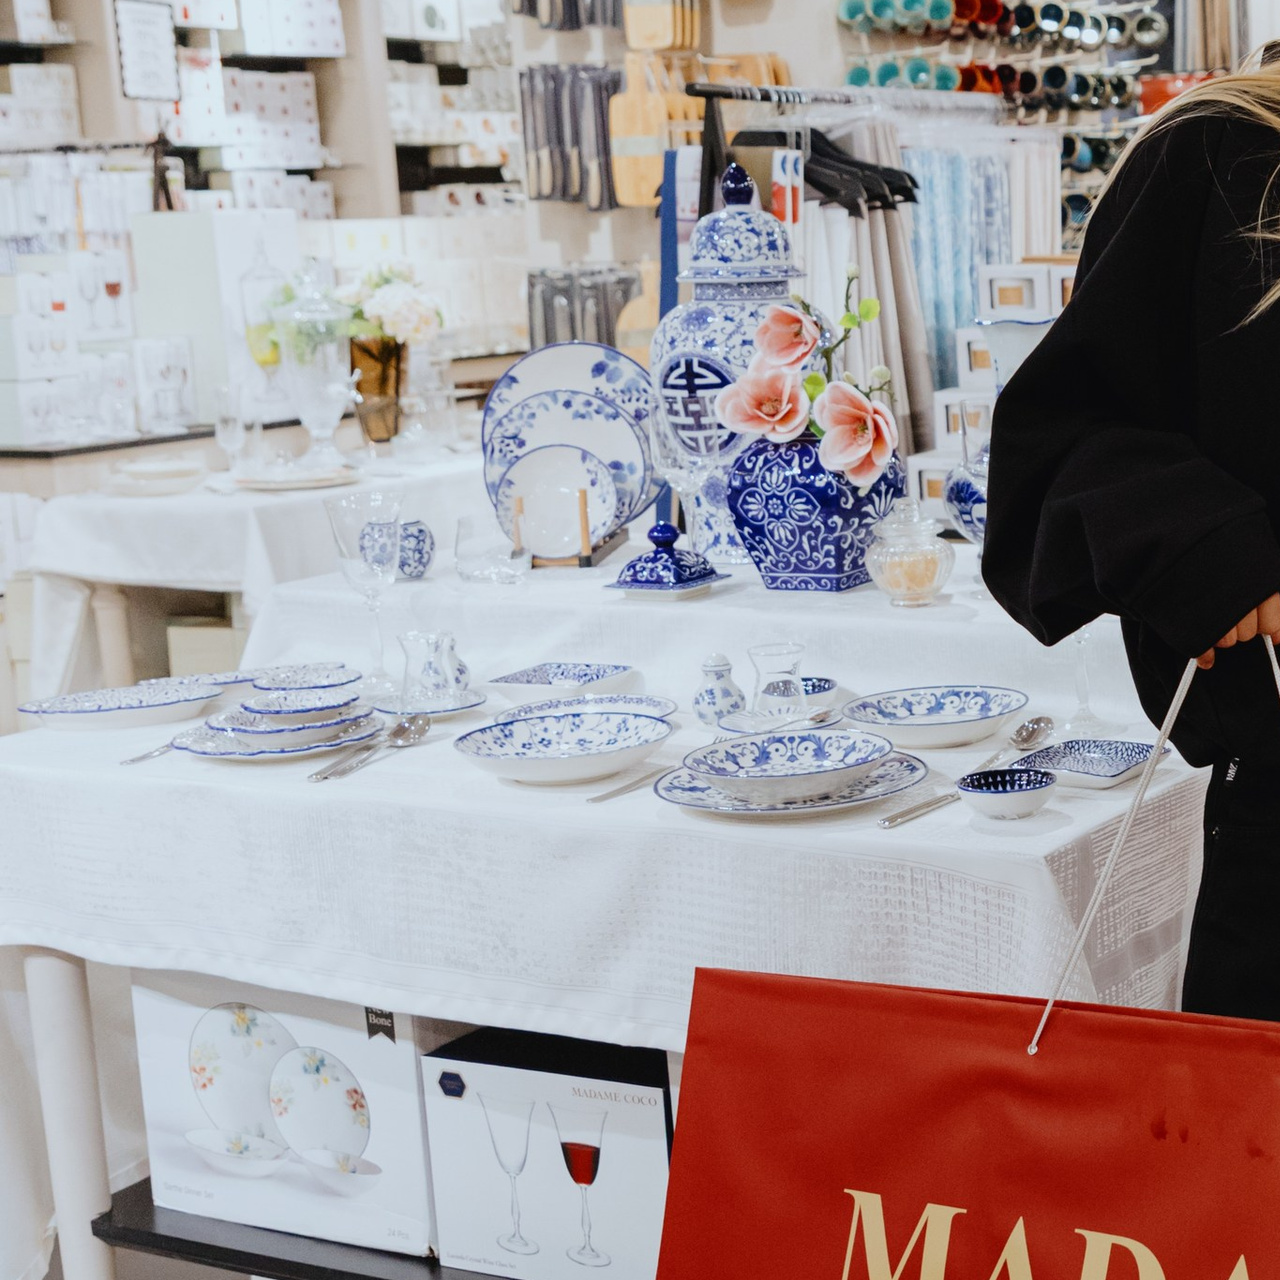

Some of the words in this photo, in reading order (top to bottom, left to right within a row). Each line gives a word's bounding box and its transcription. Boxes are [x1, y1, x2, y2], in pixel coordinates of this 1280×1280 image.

[369, 1013, 392, 1026] Bone
[572, 1087, 620, 1102] MADAME
[623, 1094, 658, 1107] COCO
